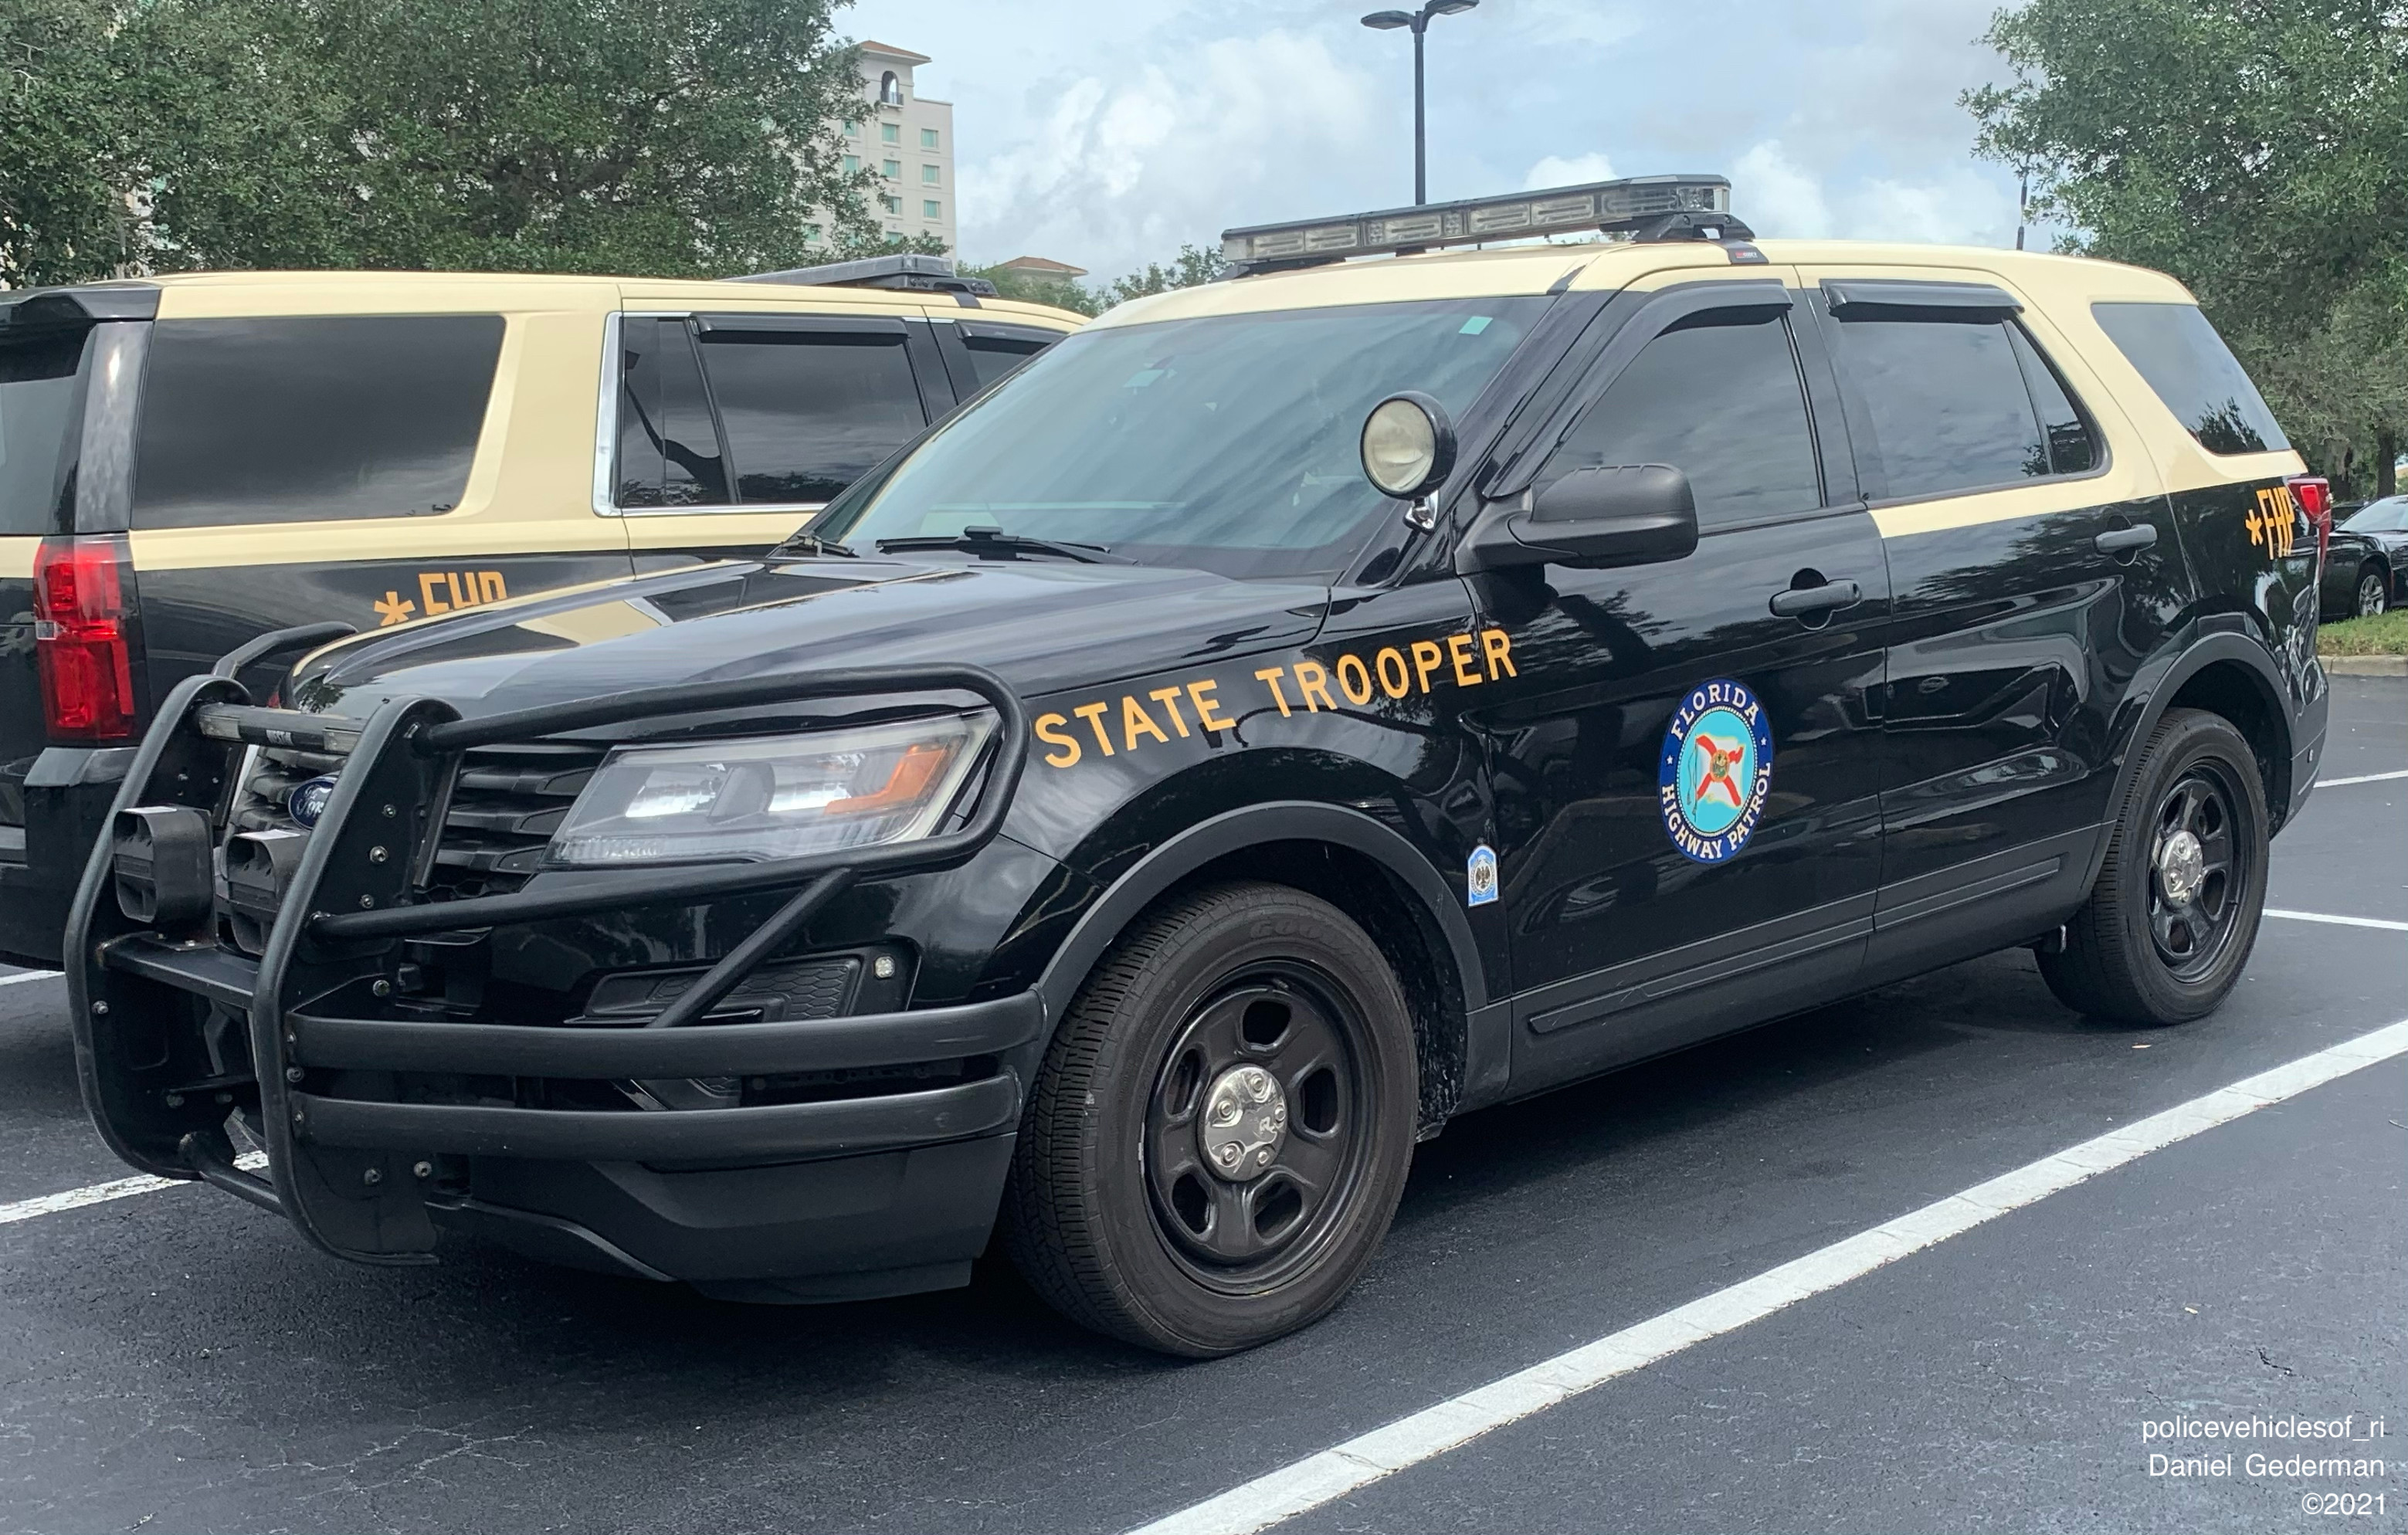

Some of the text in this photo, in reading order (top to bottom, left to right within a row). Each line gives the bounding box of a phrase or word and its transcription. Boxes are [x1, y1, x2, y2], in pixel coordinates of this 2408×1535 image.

[1034, 629, 1518, 768] STATE TROOPER
[1670, 683, 1759, 741] FLORIDA
[296, 784, 325, 817] For
[1662, 762, 1771, 859] HIGHWAY PATROL
